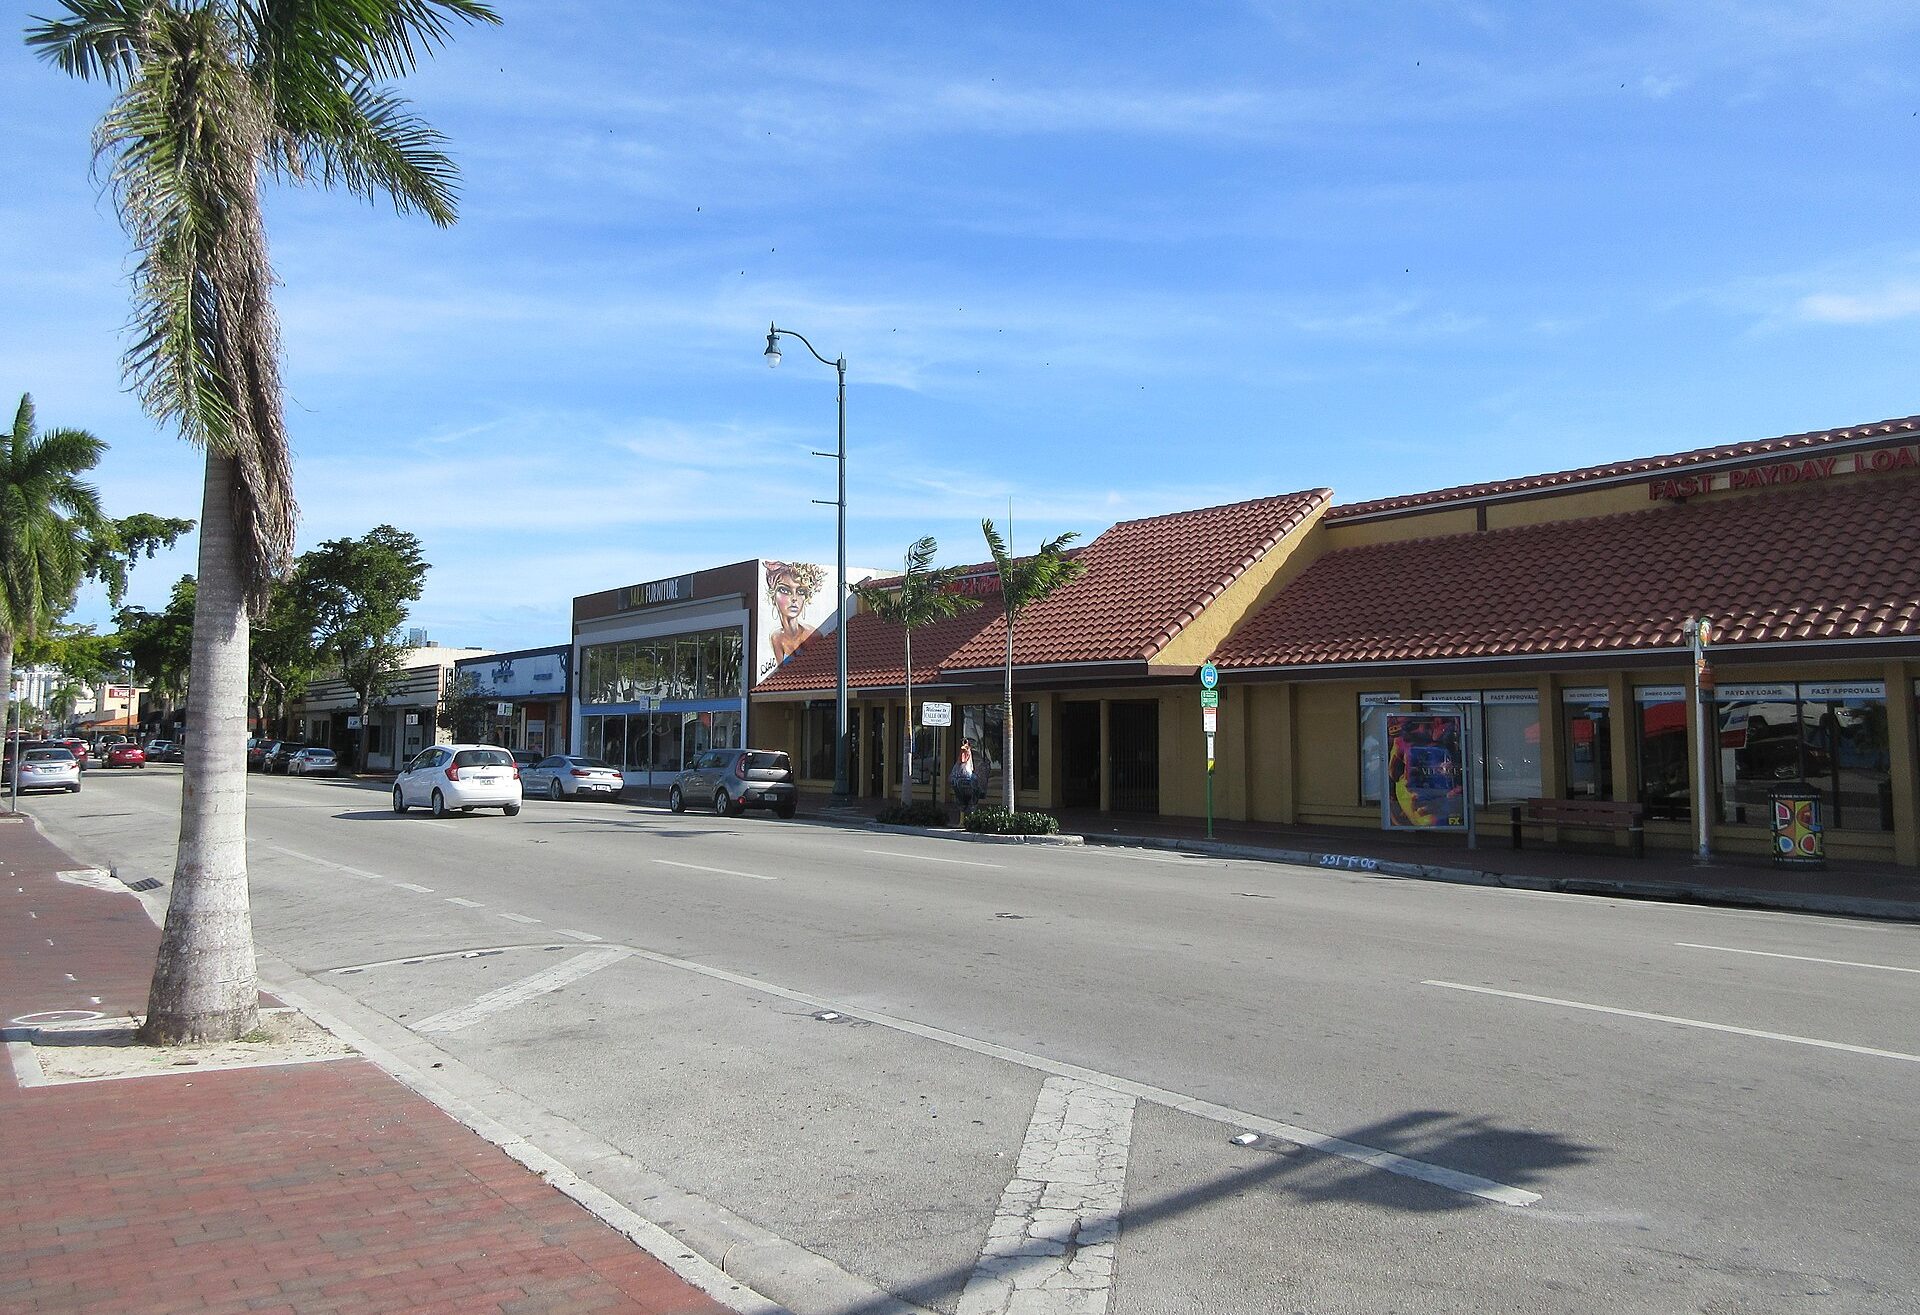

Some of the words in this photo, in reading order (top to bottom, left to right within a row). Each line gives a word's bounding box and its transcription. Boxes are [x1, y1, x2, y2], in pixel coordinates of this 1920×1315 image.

[1649, 474, 1714, 500] FAST
[1728, 457, 1837, 488] PAYDAY
[1853, 446, 1920, 475] LOA
[645, 579, 679, 604] FURNITURE
[1725, 689, 1755, 697] PAYDAY
[1756, 688, 1783, 697] LOANS
[1811, 687, 1831, 696] FAST
[1832, 686, 1881, 696] APPROVALS
[1448, 817, 1460, 825] FX
